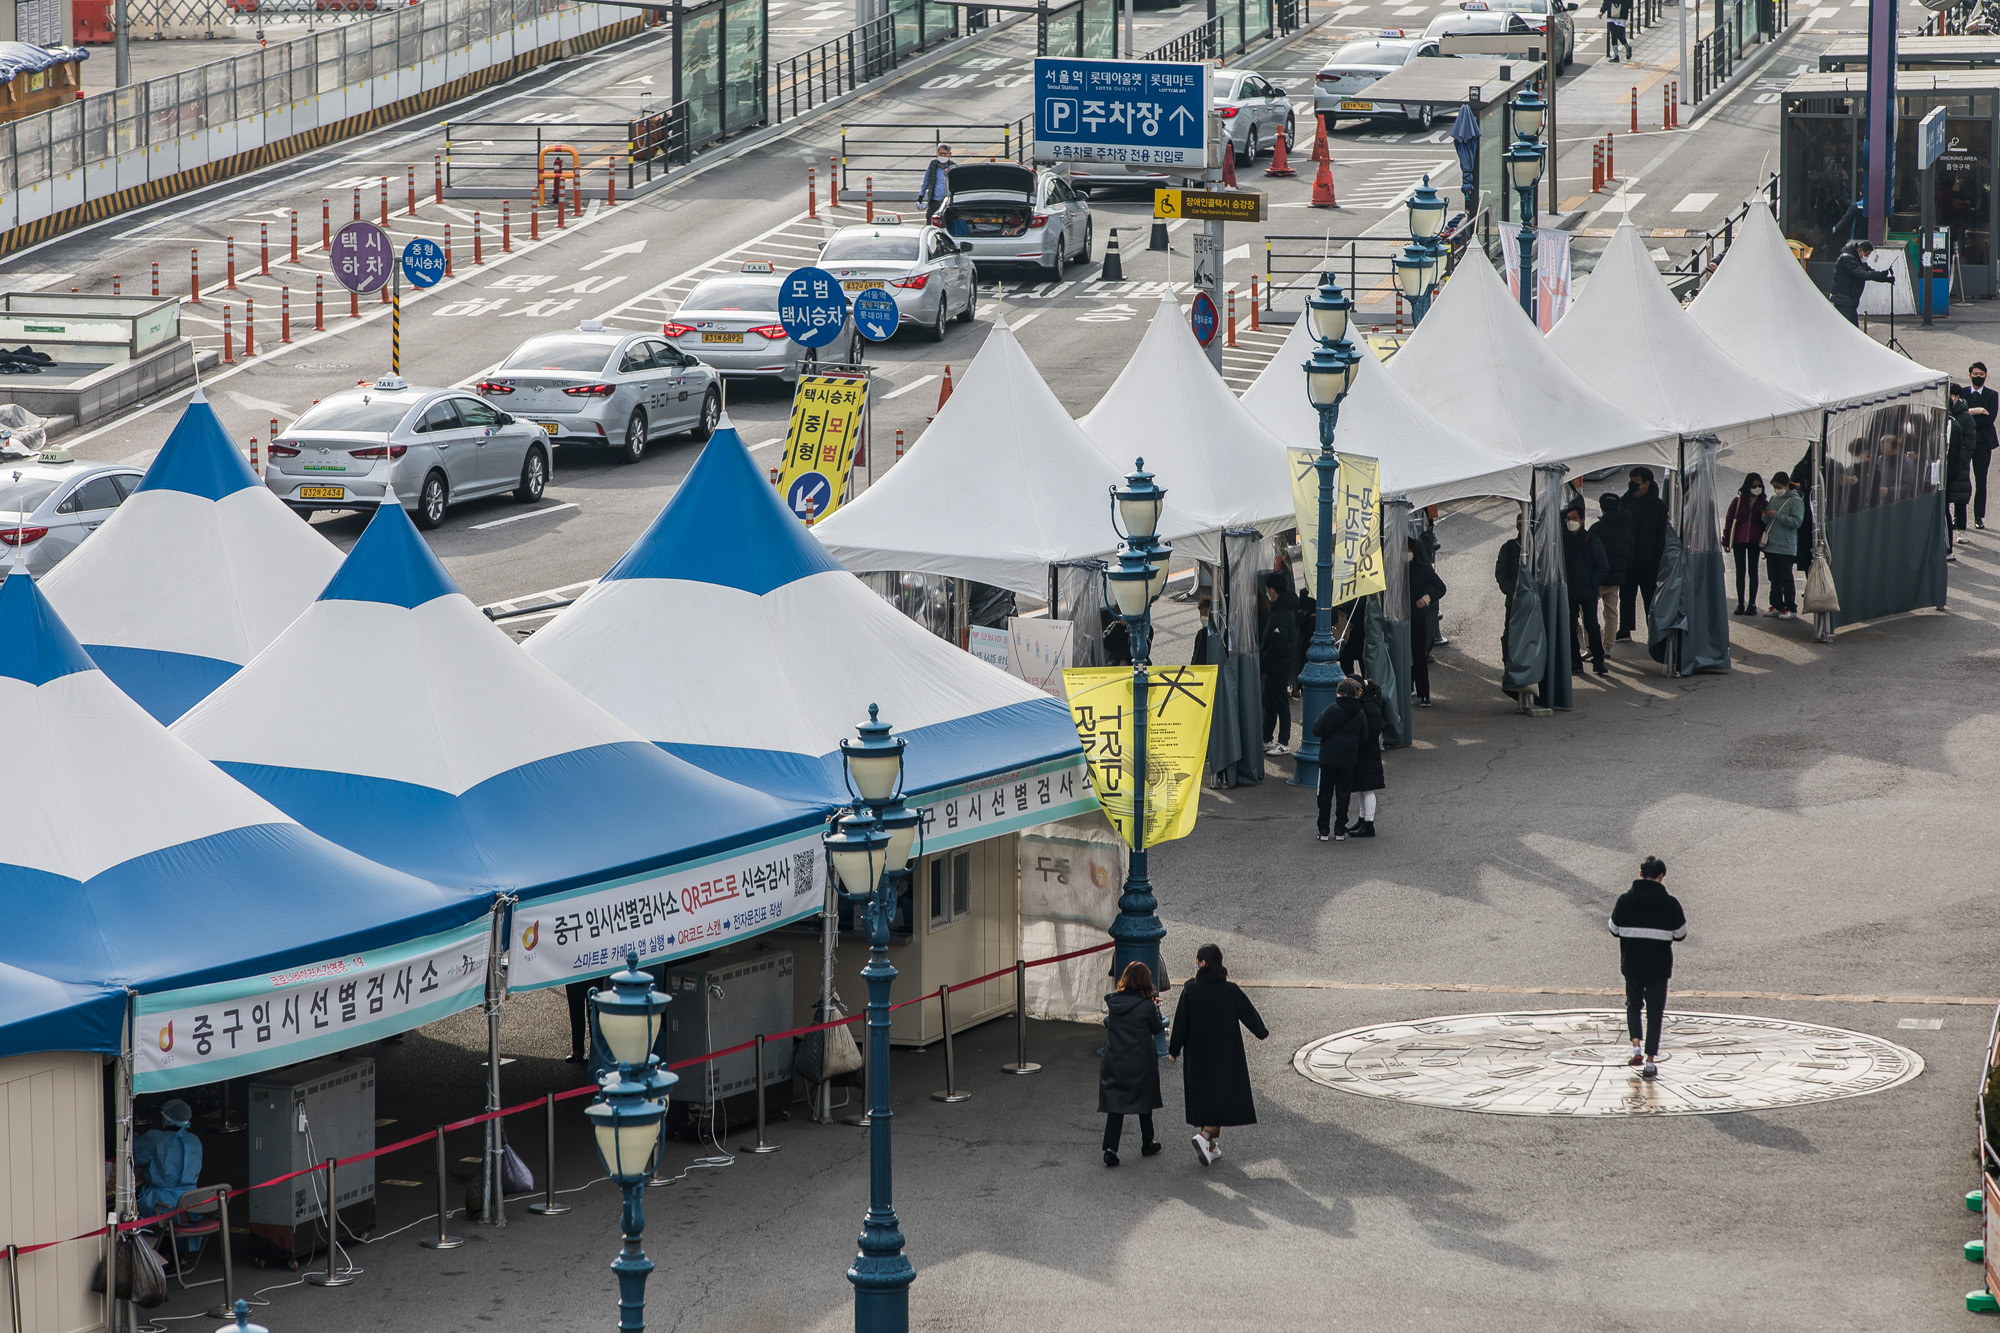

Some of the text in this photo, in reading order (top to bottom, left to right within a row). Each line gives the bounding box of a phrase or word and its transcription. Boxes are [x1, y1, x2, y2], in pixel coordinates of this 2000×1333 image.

[1046, 70, 1195, 87] 서울역 롯데아울렛 롯데마트
[1082, 100, 1163, 136] 주차장
[1052, 145, 1184, 163] 우측차로 주차장 전용 진입로
[1186, 197, 1255, 210] 장애인콜택시 승강장
[341, 232, 380, 252] 택시
[412, 243, 433, 256] 중형
[342, 256, 383, 276] 하차
[405, 256, 443, 270] 택시승차
[484, 275, 628, 294] 택시
[792, 280, 828, 299] 모범
[864, 290, 886, 300] 서울역
[432, 298, 582, 317] 하차
[782, 306, 842, 326] 택시승차
[860, 310, 891, 320] 롯데마트
[651, 392, 669, 409] 타다
[804, 388, 856, 405] 택시승차
[799, 415, 821, 461] 중형
[822, 418, 843, 462] 모범
[554, 856, 790, 946] 중구 임시선별검사소 QR코드로 신속검사
[572, 900, 782, 969] 스마트폰 카메라 앱 실행 QR코드 스캔 전자문진표 작성
